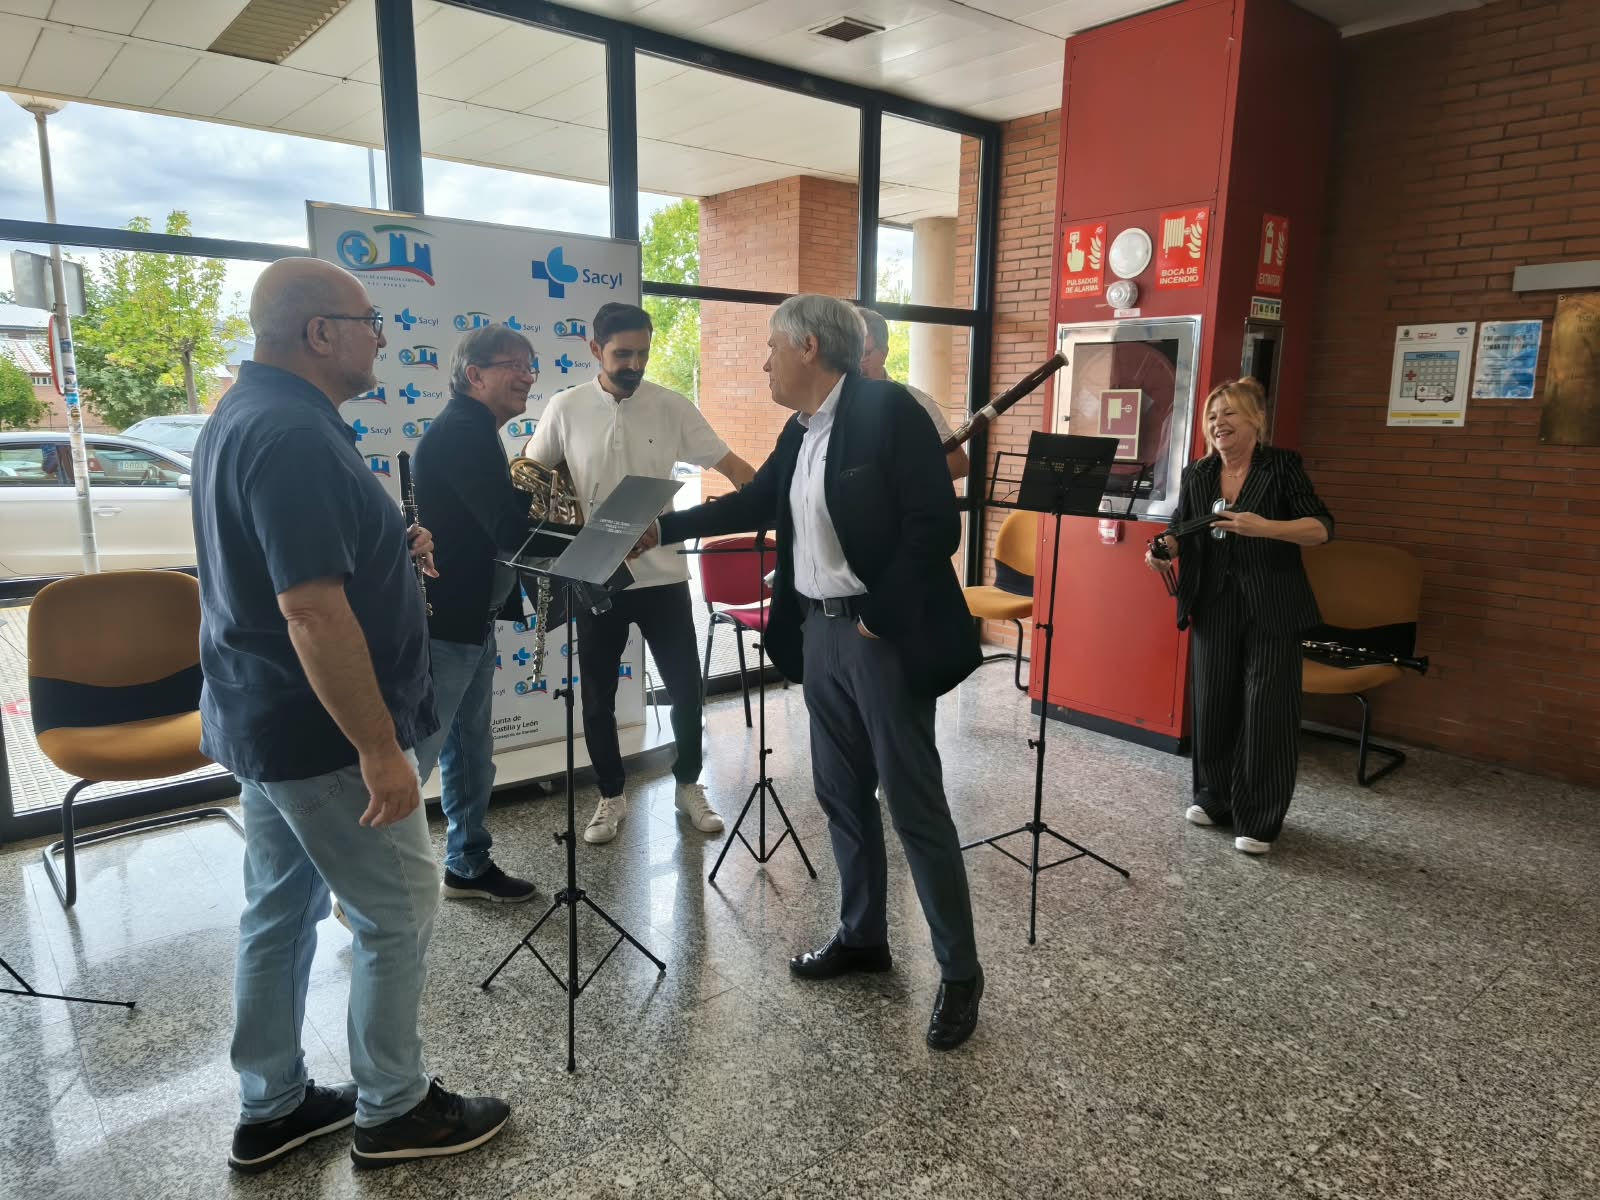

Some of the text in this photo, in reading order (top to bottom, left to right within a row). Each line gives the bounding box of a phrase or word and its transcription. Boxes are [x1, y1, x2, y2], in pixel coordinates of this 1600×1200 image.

[1161, 266, 1199, 277] BOCA DE
[582, 268, 623, 290] Sacyl
[1066, 276, 1099, 286] PULSADOR
[1160, 274, 1199, 285] INCENDIO
[1065, 284, 1099, 294] DE ALARMA
[418, 317, 439, 326] Sacyl
[523, 324, 541, 332] Sacyl
[574, 360, 591, 368] Sacyl
[422, 390, 443, 399] Sacyl
[370, 427, 392, 435] Sacyl
[492, 717, 511, 725] Junta
[492, 725, 516, 733] Castilla
[516, 723, 521, 731] y
